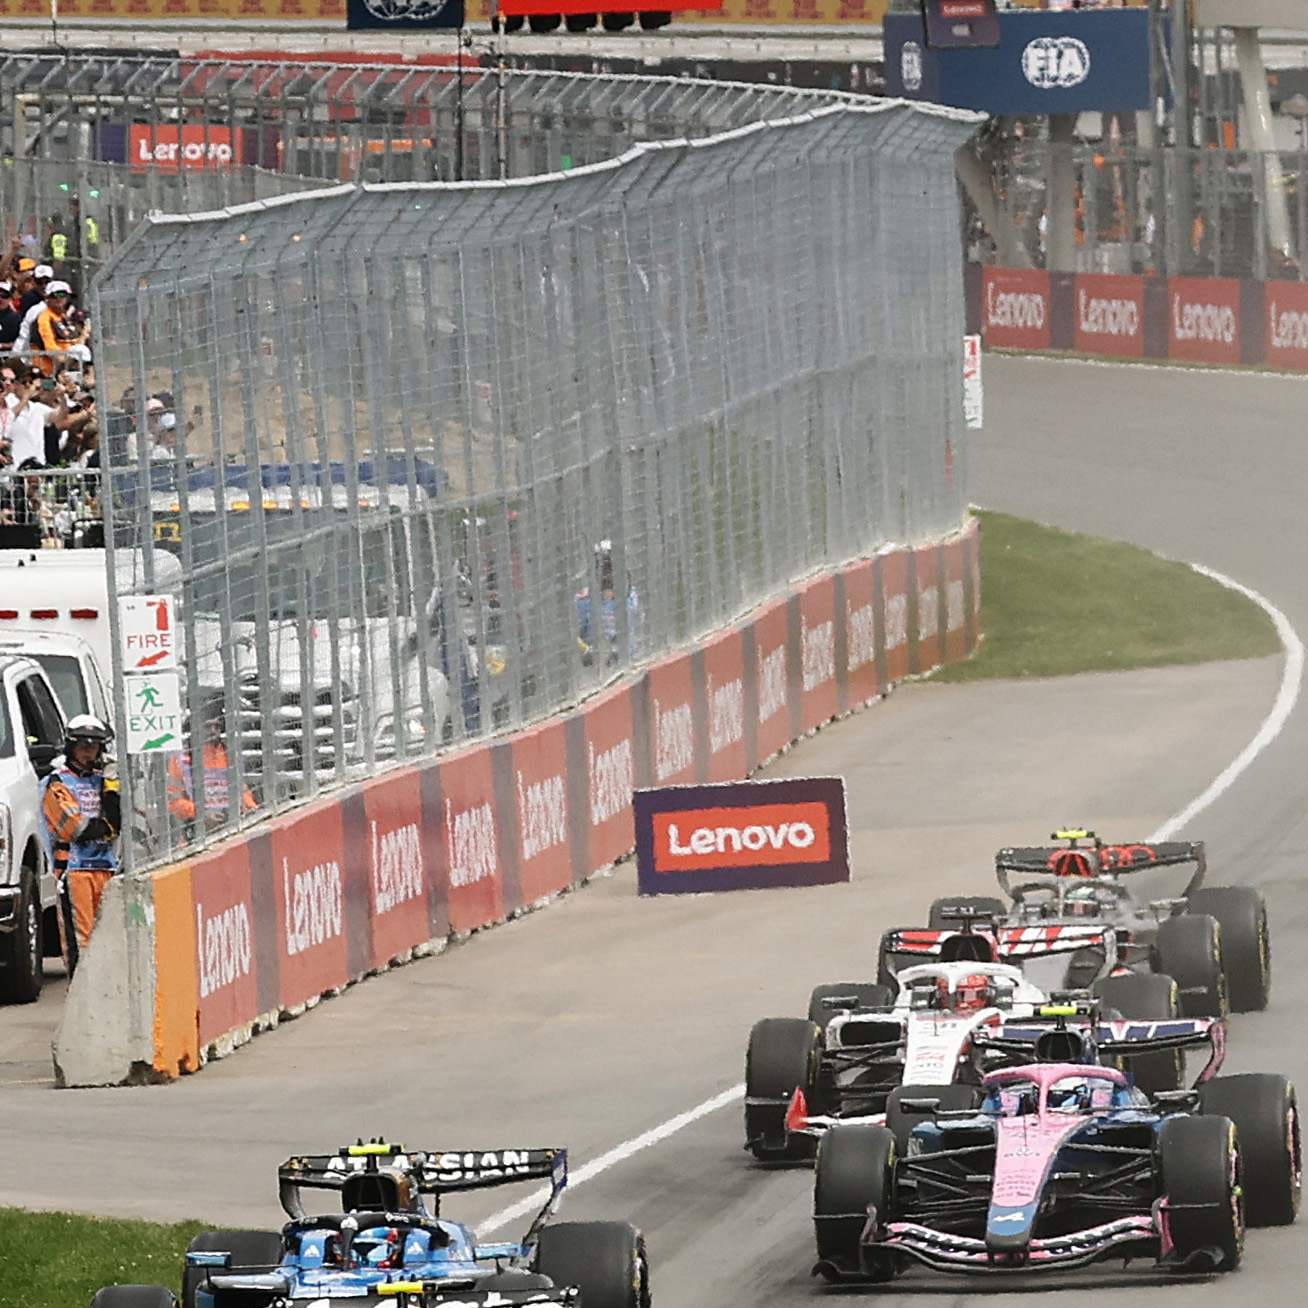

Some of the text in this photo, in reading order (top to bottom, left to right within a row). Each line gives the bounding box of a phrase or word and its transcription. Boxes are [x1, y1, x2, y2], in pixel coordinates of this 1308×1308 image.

[127, 633, 171, 648] FIRE
[130, 715, 176, 732] EXIT
[668, 821, 815, 856] Lenovo
